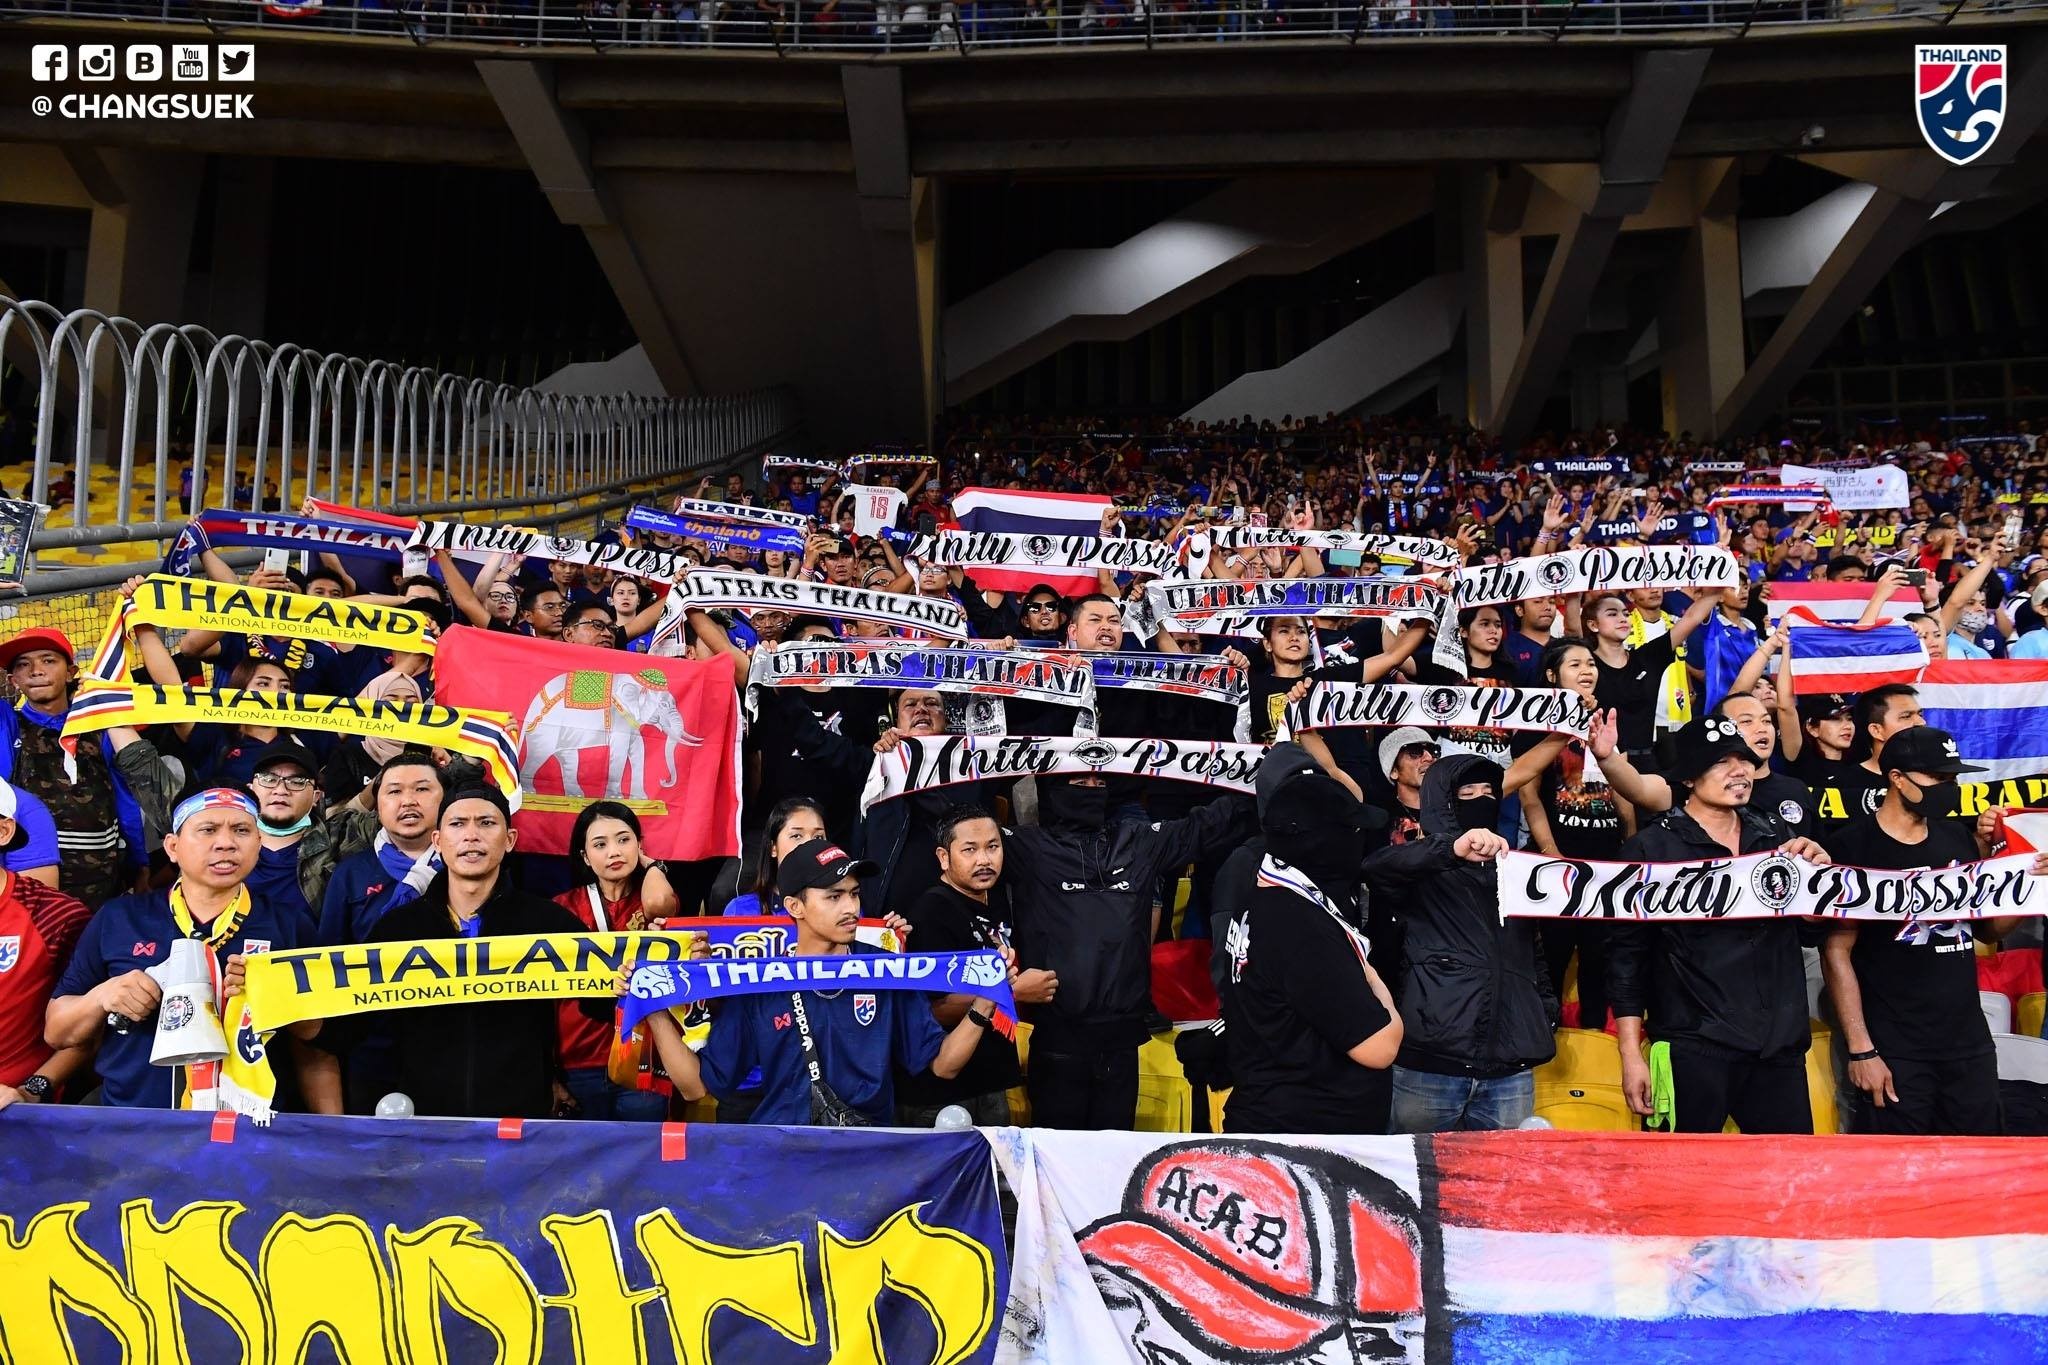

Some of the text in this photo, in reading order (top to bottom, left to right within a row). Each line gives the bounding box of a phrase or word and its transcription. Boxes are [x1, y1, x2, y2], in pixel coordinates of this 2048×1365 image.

[1378, 473, 1419, 482] THAAND
[1554, 462, 1613, 472] THAILAND
[870, 495, 889, 520] 18
[240, 518, 408, 552] THAILAN
[1597, 518, 1679, 536] THAIND
[585, 540, 688, 578] Pass
[1448, 561, 1531, 602] nity
[1579, 545, 1733, 591] Passion
[142, 578, 421, 636] THAILAND
[675, 573, 961, 629] ULTRAS THAILAND
[1165, 582, 1290, 610] ULTRAS
[199, 614, 369, 641] NATIONAL FOOTBALL TEAM
[772, 651, 903, 676] ULTRAS
[152, 684, 460, 730] THAILAND
[202, 708, 395, 733] NATIONAL FOOTBALL TEAM
[1524, 858, 1743, 919] Unity
[271, 935, 682, 995] THAILAND
[699, 955, 938, 989] THAILAND
[353, 978, 615, 1007] NATIONAL FOOTBALL TEAM
[791, 991, 810, 1035] adidas
